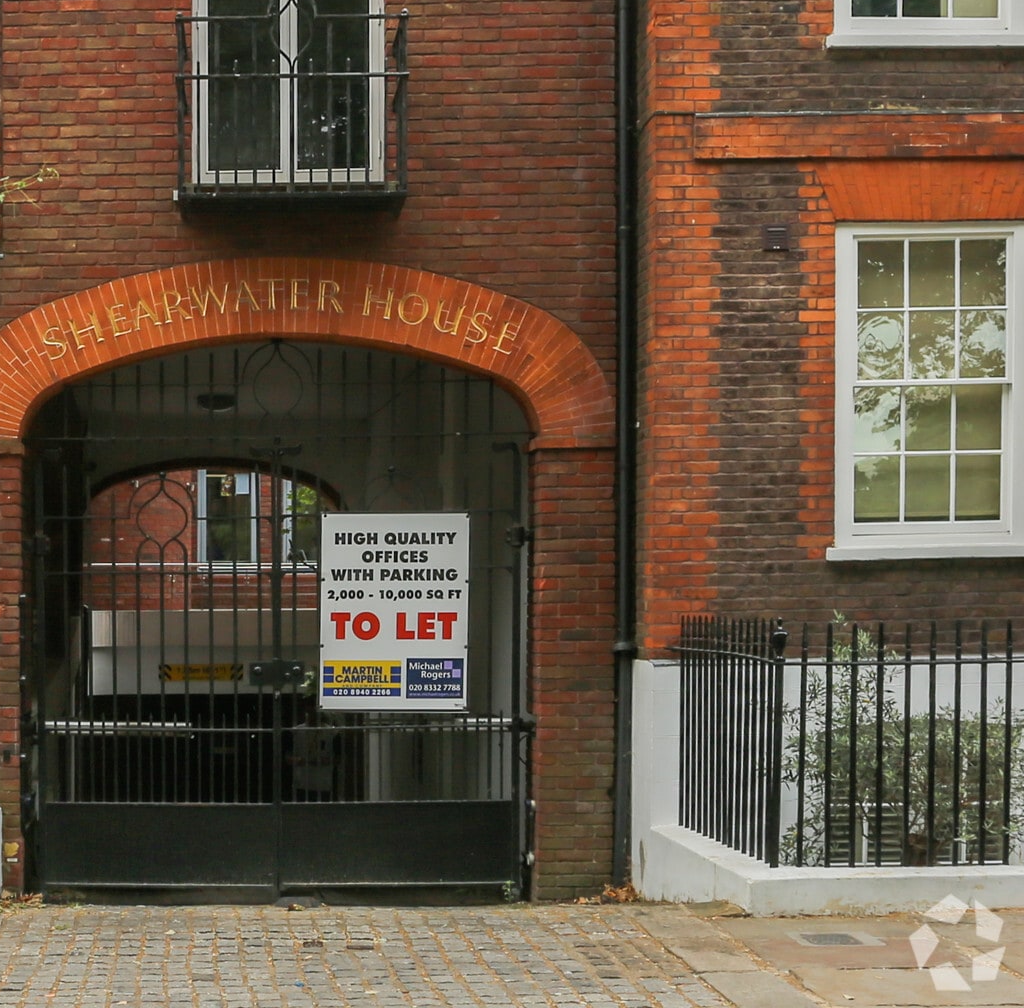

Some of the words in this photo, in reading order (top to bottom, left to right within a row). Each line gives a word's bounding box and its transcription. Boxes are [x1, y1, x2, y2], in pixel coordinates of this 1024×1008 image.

[41, 278, 345, 361] SHEARWATER
[361, 284, 523, 356] HOUSE
[334, 532, 378, 545] HIGH
[384, 532, 457, 545] QUALITY
[361, 550, 429, 563] OFFICES
[331, 569, 374, 581] WITH
[380, 568, 458, 581] PARKING
[327, 590, 364, 601] 2,000
[379, 590, 422, 601] 10,000
[426, 589, 444, 600] SQ
[448, 589, 462, 600] FT
[330, 611, 381, 641] TO
[396, 612, 458, 640] LET
[342, 666, 383, 674] MARTIN
[409, 661, 443, 670] Michael
[335, 674, 389, 683] CAMPBELL
[420, 671, 451, 680] Rogers
